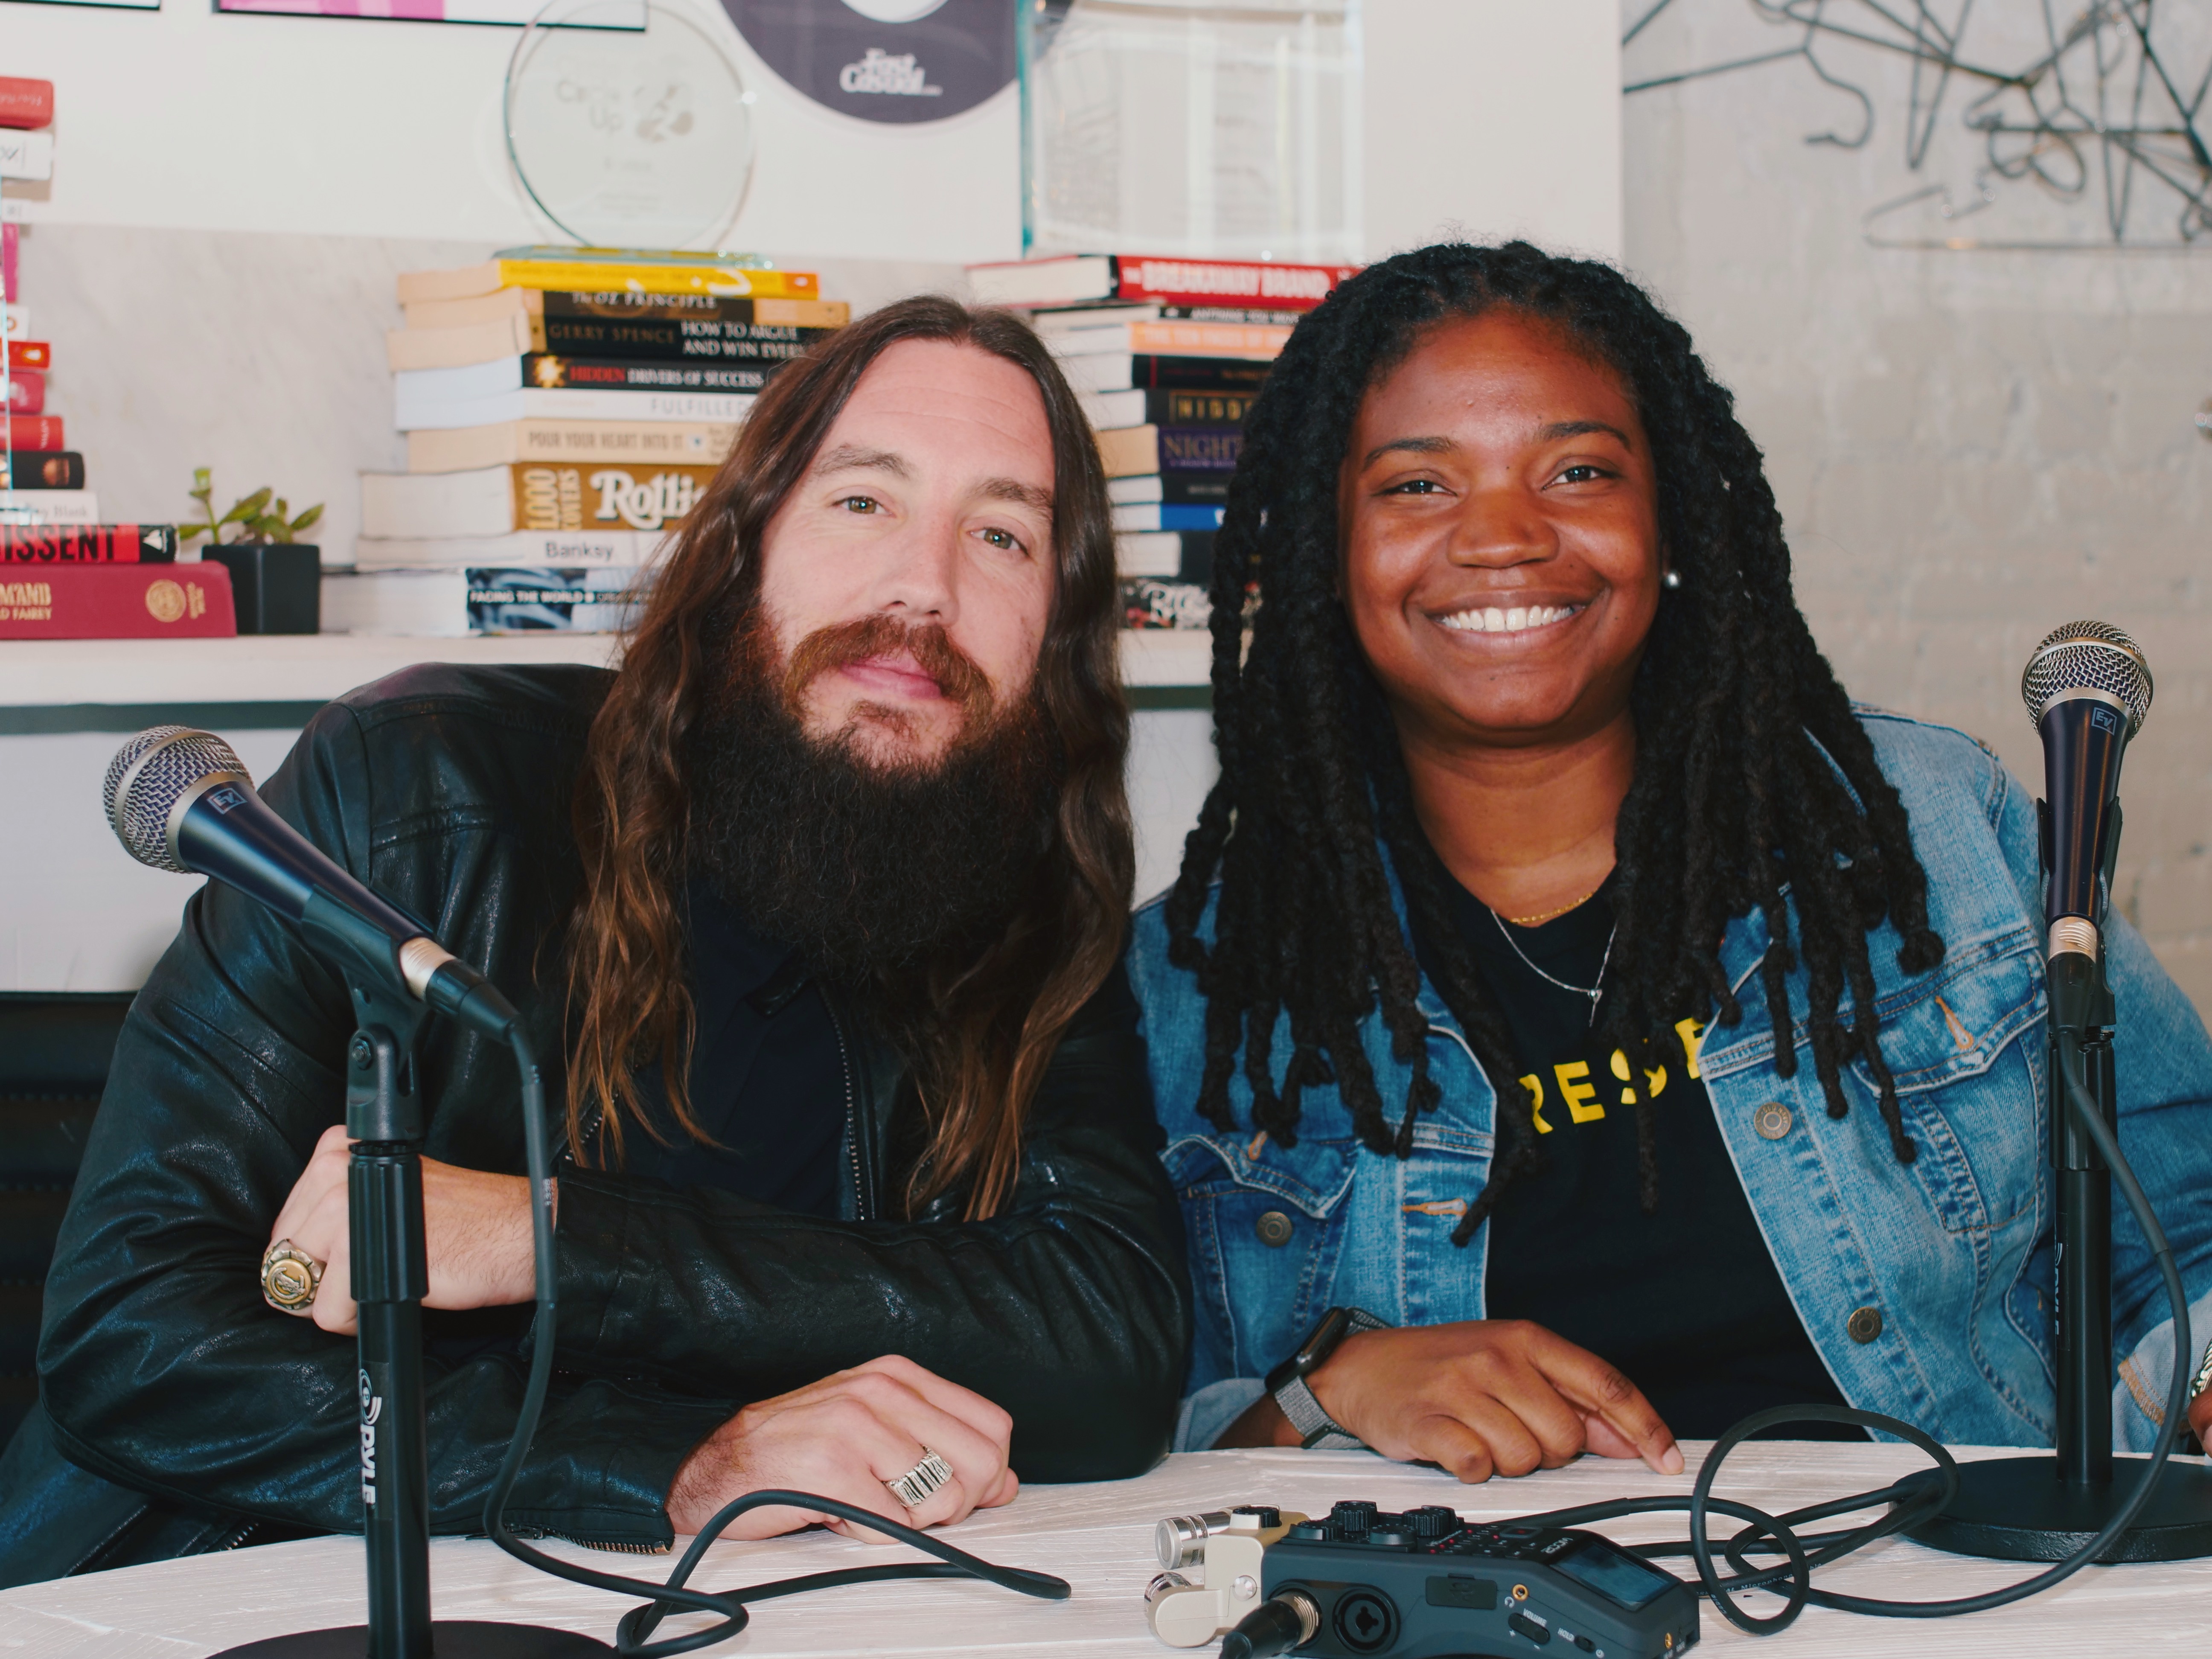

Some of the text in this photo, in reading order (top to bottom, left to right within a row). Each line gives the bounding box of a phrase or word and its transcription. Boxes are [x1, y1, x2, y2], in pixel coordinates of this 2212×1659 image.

[1260, 266, 1331, 299] BRAND
[549, 323, 674, 343] GERRY SPENCE
[681, 320, 797, 341] HOW TO ARGUE
[683, 338, 721, 355] AND
[722, 340, 758, 357] WIN
[570, 366, 765, 387] HIDDEN DRIVERS OF SUCCESS
[529, 432, 682, 450] POUR YOUR HEART INTO IT
[559, 469, 582, 532] COVERS
[0, 524, 116, 562] ISSENT
[545, 541, 614, 561] Banksy
[469, 589, 515, 603] FACING
[516, 590, 539, 603] THE
[540, 590, 583, 603] WORLD
[2096, 711, 2113, 727] EV
[360, 1424, 376, 1505] PYLE
[1741, 1574, 1793, 1590] Microphone
[1522, 1607, 1548, 1627] VOLUME
[1557, 1627, 1576, 1642] HOLD
